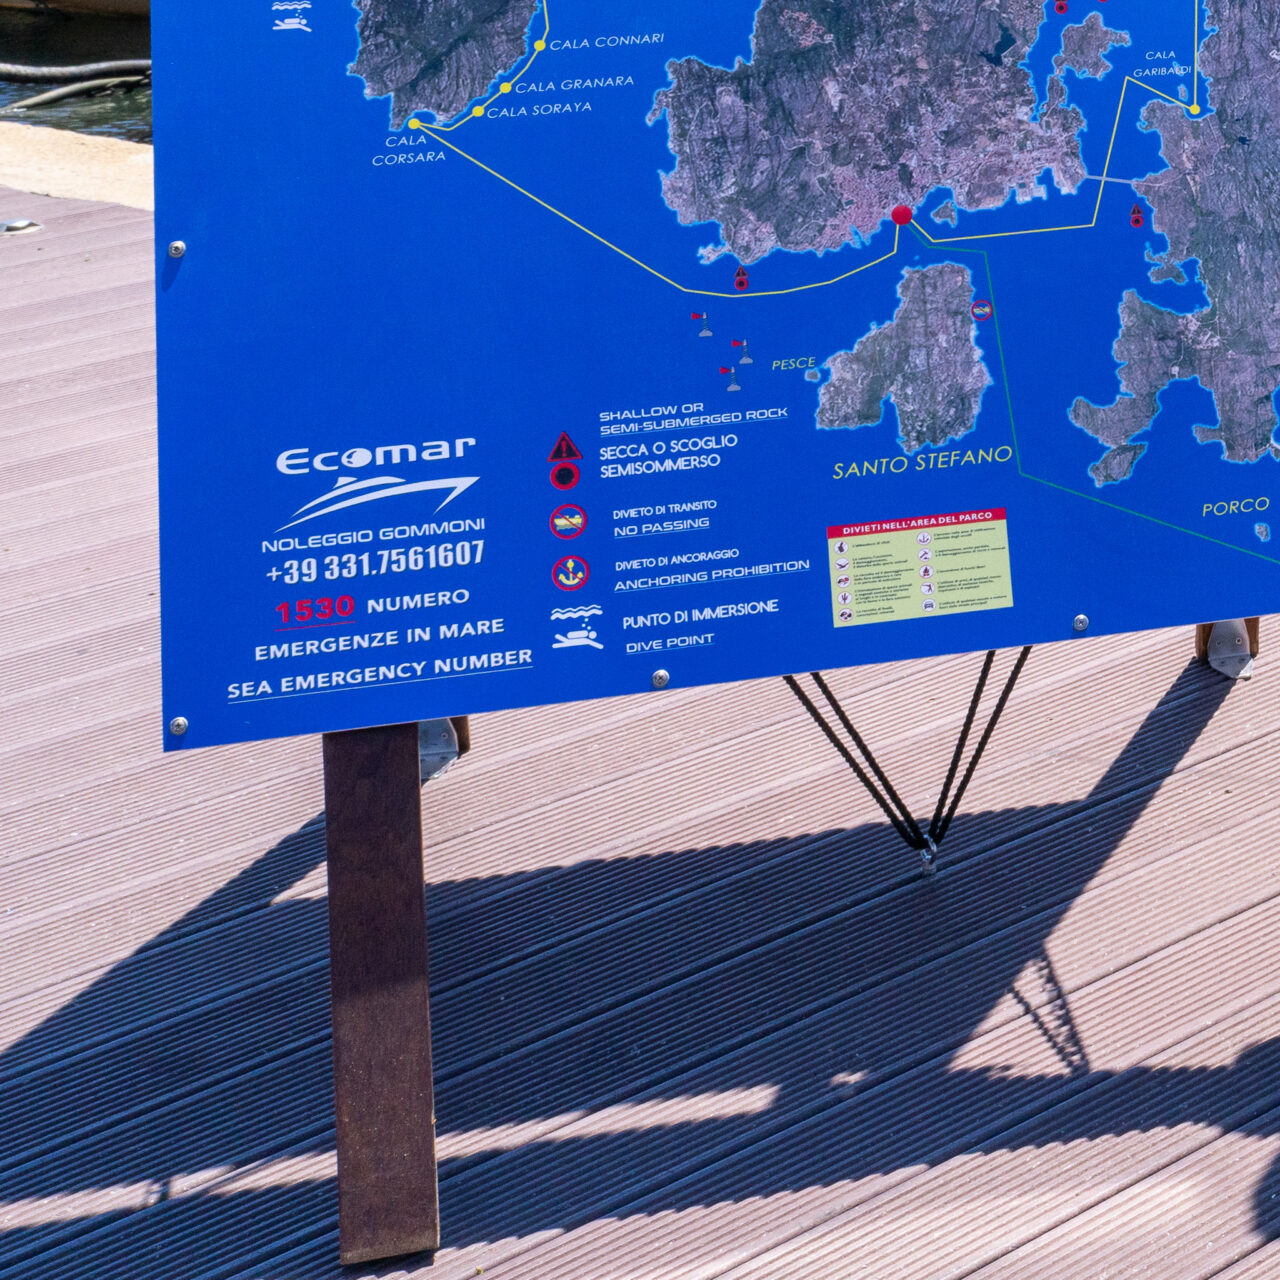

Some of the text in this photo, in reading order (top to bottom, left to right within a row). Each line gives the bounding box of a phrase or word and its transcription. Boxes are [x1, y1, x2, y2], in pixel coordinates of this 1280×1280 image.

[549, 32, 665, 51] CALA CONNARI
[1145, 50, 1176, 61] CALA
[1133, 66, 1192, 77] GARIBALDI
[515, 75, 634, 94] CALA GRANARA
[486, 101, 592, 119] CALA SORAYA
[385, 134, 427, 148] CALA
[371, 151, 446, 167] CORSARA
[771, 356, 816, 371] PESCE
[599, 402, 704, 422] SHALLOW OR
[600, 407, 788, 435] SEMI-SUBMERGED ROCK
[275, 437, 476, 475] Ecomar
[599, 433, 738, 461] SECCA O SCOGLIO
[600, 454, 720, 478] SEMISOMMERSO
[832, 445, 1013, 480] SANTO STEFANO
[612, 499, 718, 520] DIVIETO DI TRANSITO
[1202, 496, 1270, 517] PORCO
[261, 517, 486, 553] NOLEGGIO GOMMONI
[613, 518, 710, 537] NO PASSING
[843, 511, 993, 535] DIVIETI NELL'AREA DEL PARCO
[266, 540, 484, 585] +39 331.7561607
[615, 548, 740, 572] DIVIETO DI ANCORAGGIO
[614, 559, 810, 591] ANCHORING PROHIBITION
[275, 589, 470, 623] 1530 NUMERO
[622, 598, 780, 630] PUNTO DI IMMERSIONE
[255, 618, 505, 661] EMERGENZE IN MARE
[626, 633, 715, 653] DIVE POINT
[227, 649, 532, 698] SEA EMERGENCY NUMBER
